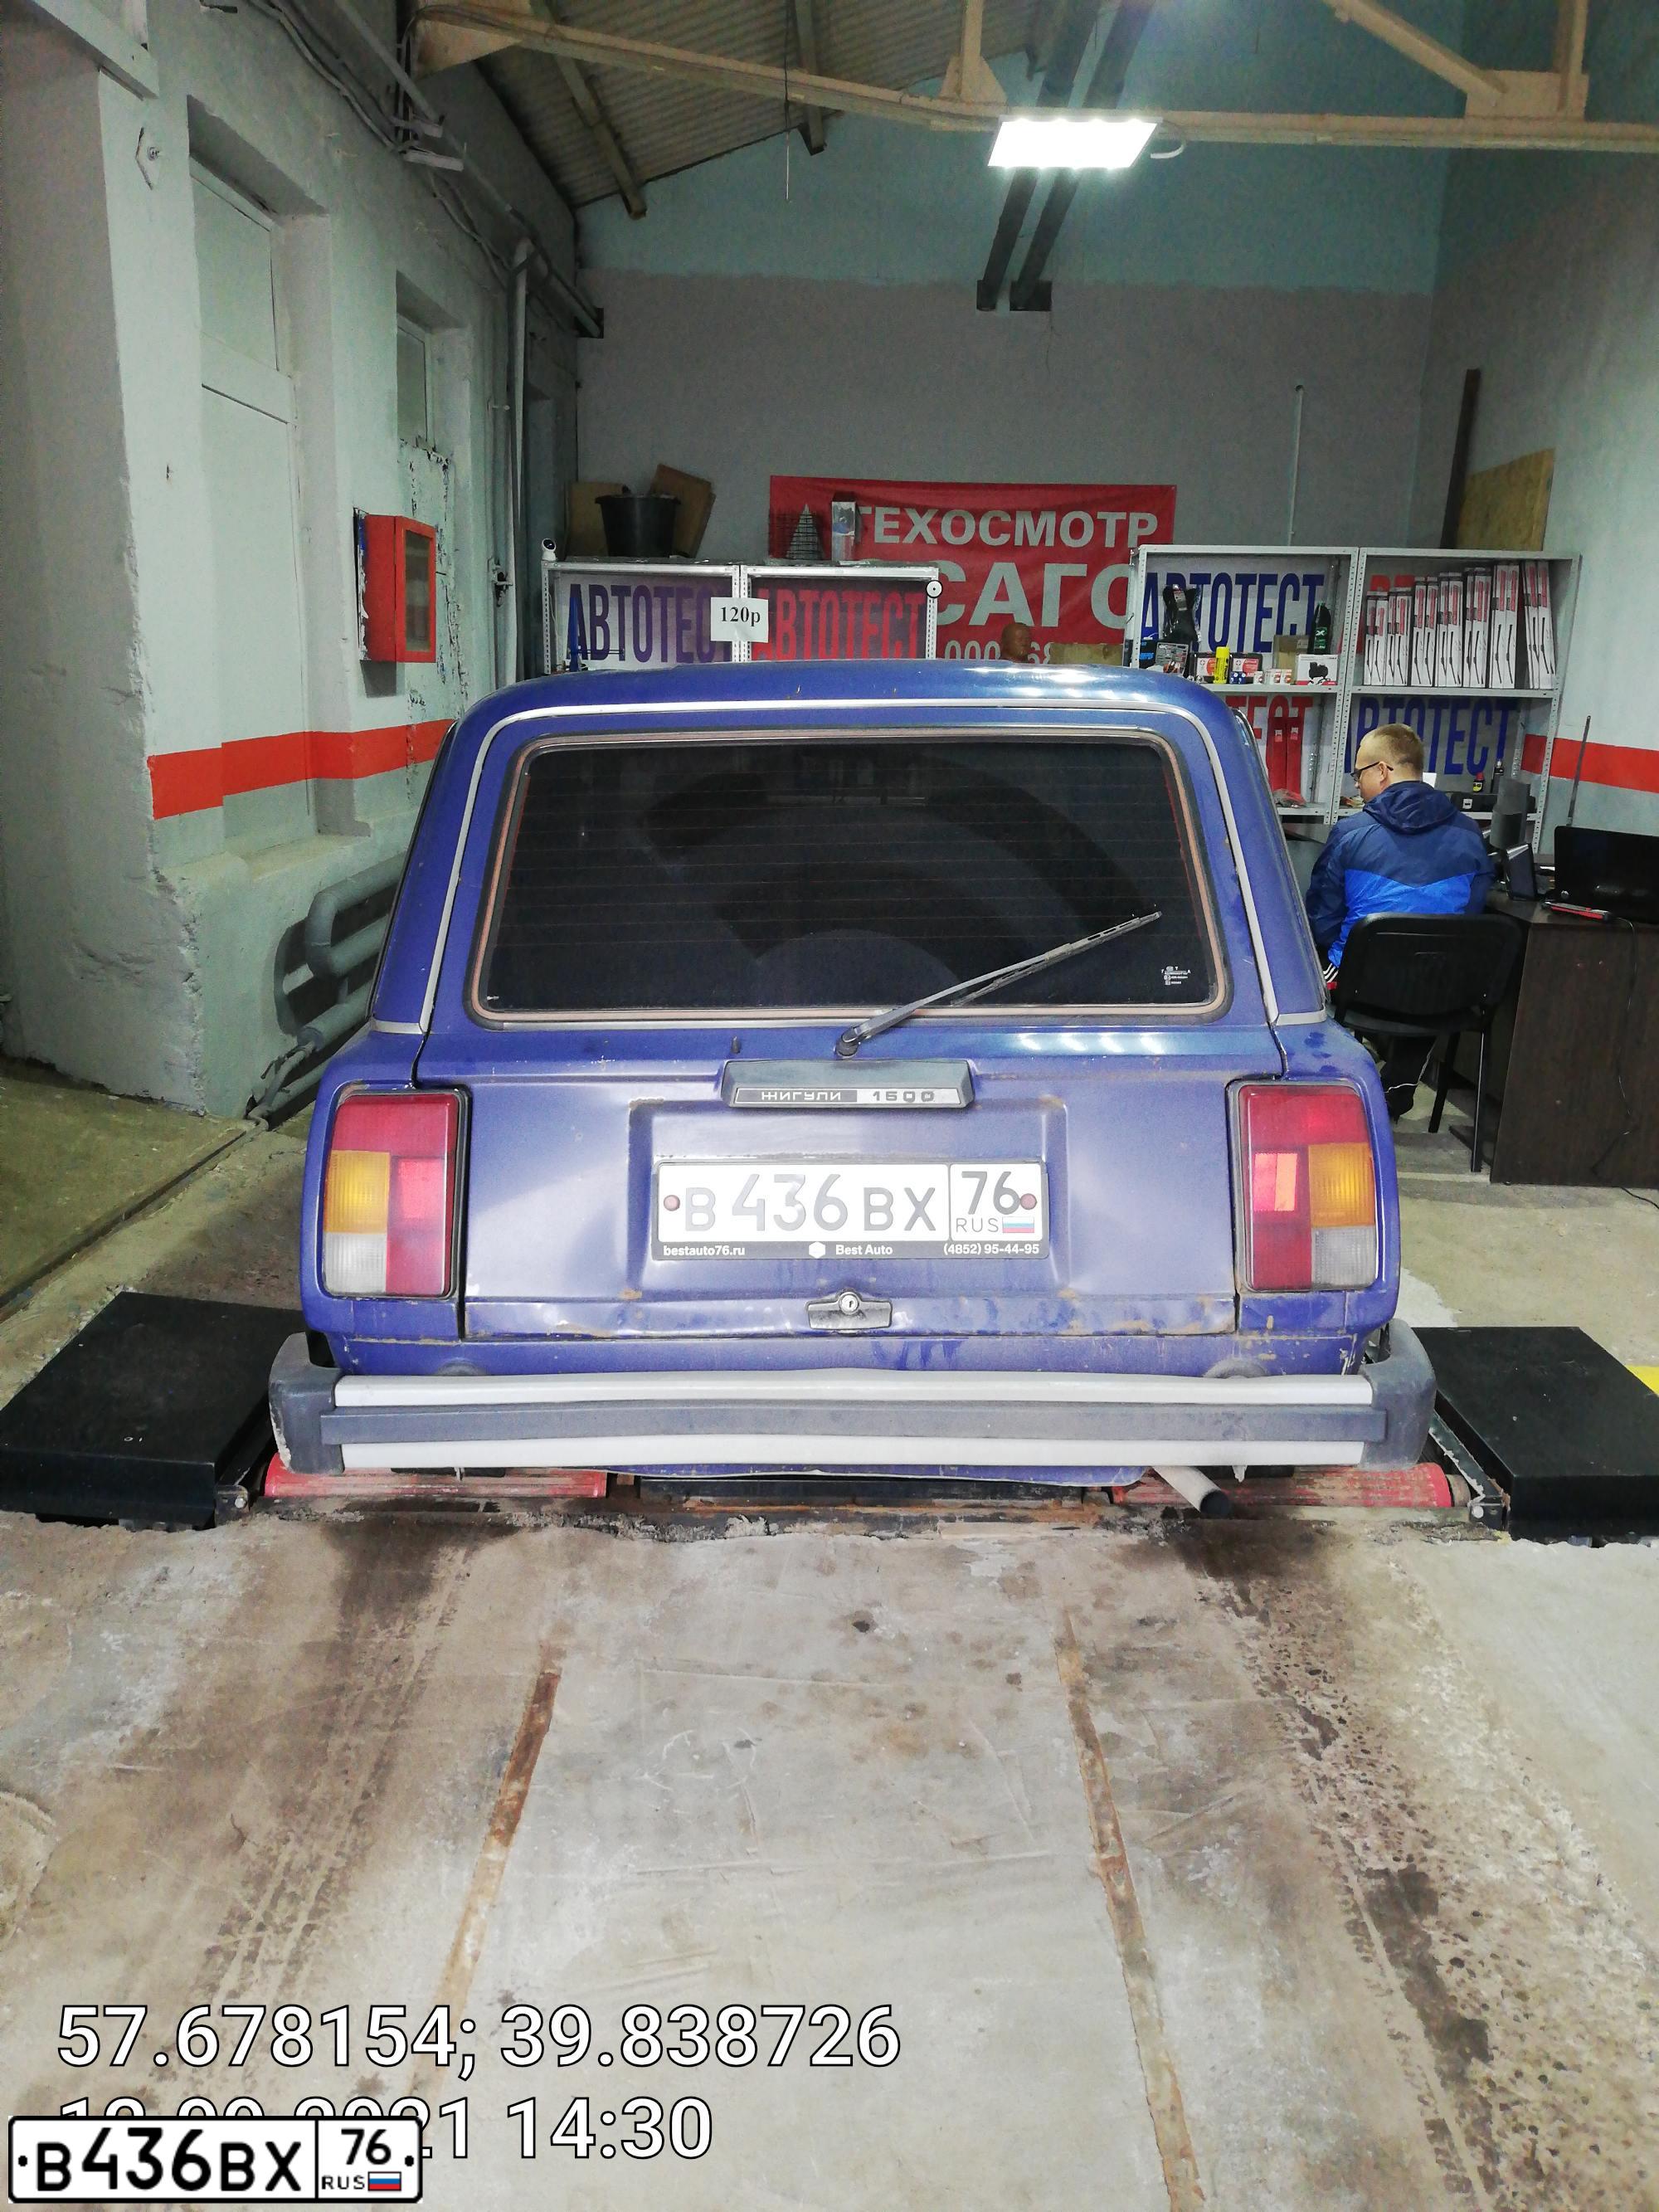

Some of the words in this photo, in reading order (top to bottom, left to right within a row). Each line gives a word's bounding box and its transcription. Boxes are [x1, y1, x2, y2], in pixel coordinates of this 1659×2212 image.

[1141, 572, 1325, 653] АТОТЕСТ
[1345, 697, 1520, 776] ВТОТЕСТ
[761, 1089, 841, 1102] ЖИГУЛИ
[872, 1089, 935, 1103] 1500
[961, 1171, 1021, 1216] 76
[956, 1216, 1000, 1234] RUS
[663, 1245, 746, 1257] bestauto76.ru
[835, 1245, 863, 1256] Best
[865, 1245, 893, 1256] Auto
[943, 1243, 981, 1256] (4852)
[984, 1243, 1039, 1255] 95-44-95
